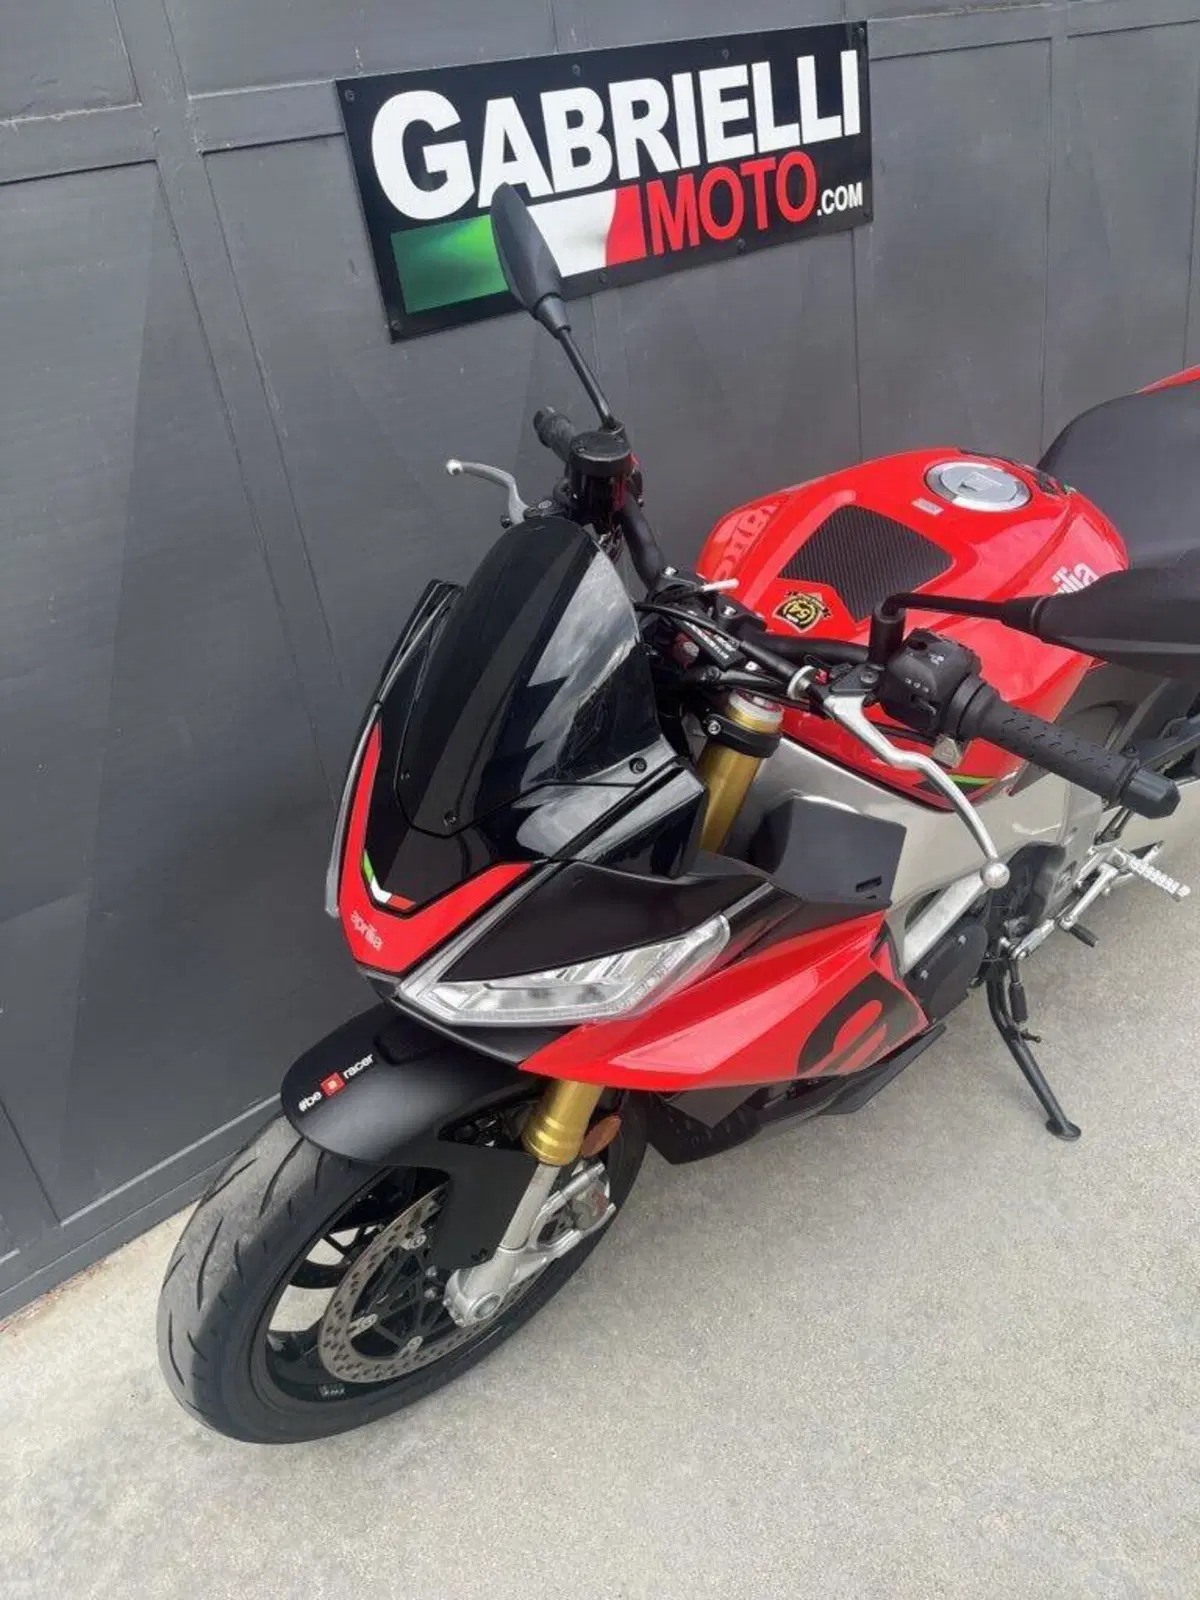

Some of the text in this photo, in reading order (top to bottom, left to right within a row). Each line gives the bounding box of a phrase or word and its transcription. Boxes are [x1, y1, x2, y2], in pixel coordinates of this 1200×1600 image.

[371, 49, 862, 220] GABRIELLI
[646, 150, 863, 256] MOTO .COM
[351, 910, 383, 952] aprilia
[342, 1053, 374, 1079] racer
